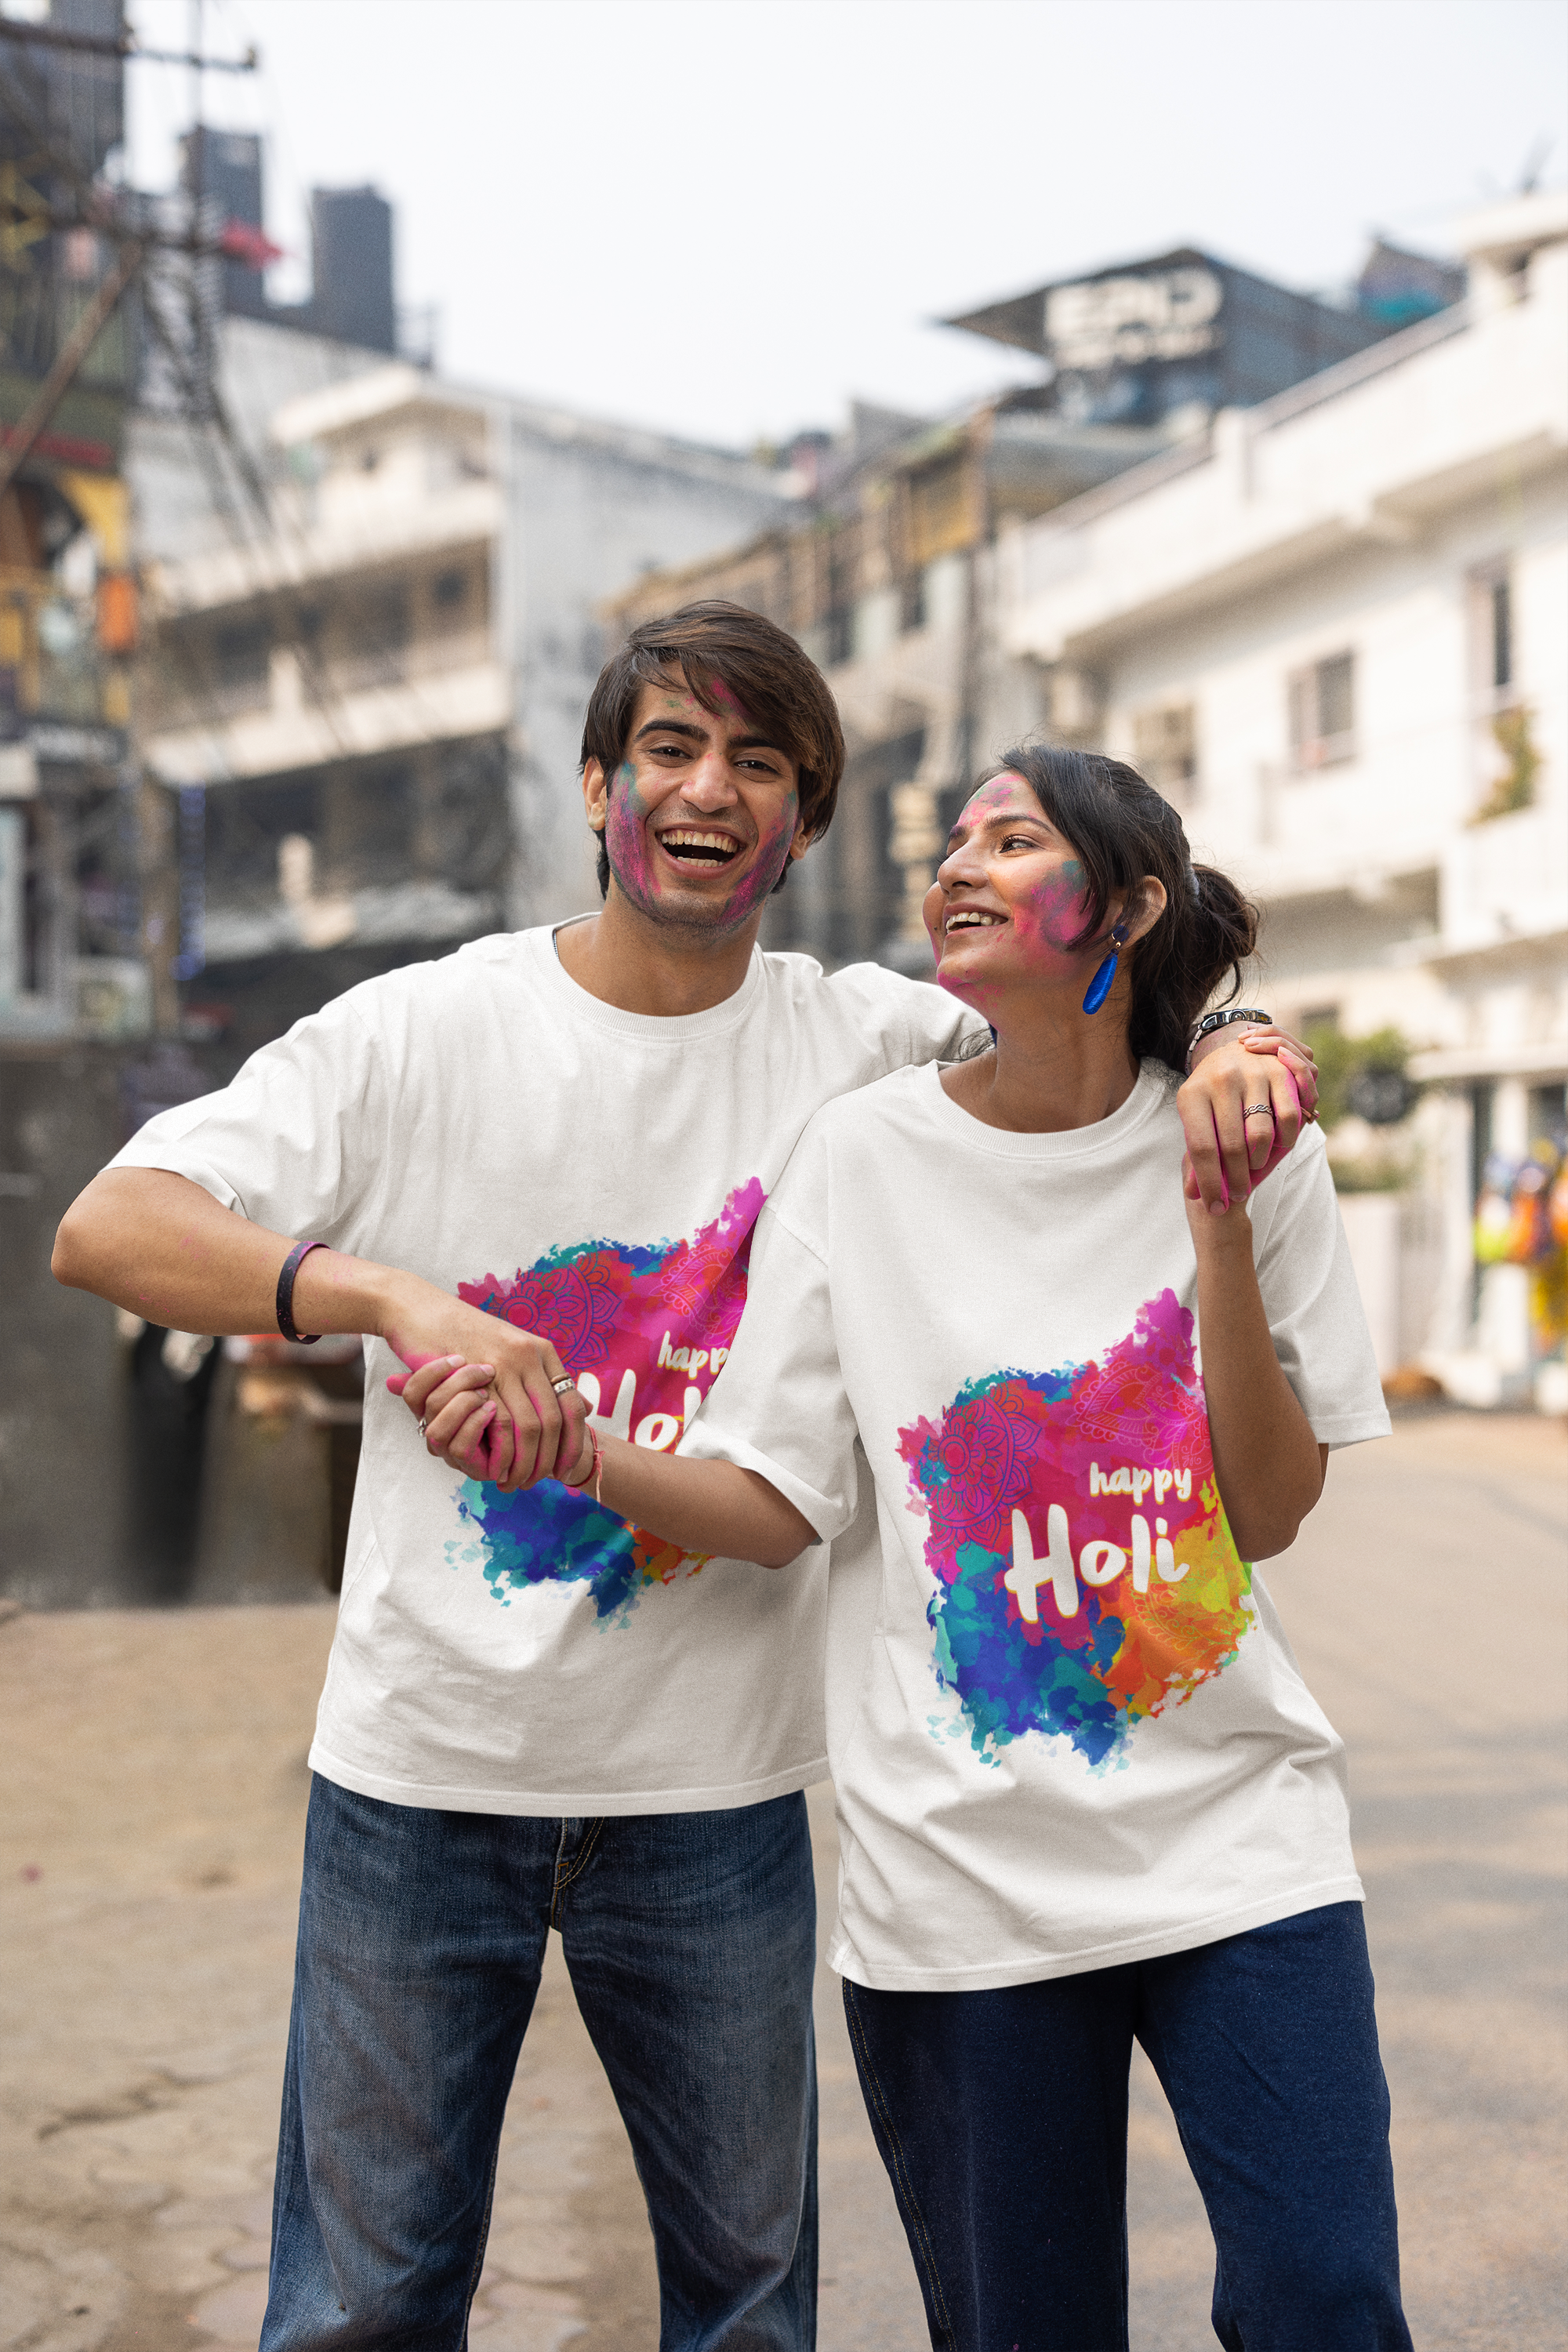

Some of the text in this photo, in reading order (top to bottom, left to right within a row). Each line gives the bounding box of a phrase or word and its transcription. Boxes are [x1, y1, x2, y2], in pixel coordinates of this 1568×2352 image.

[657, 1330, 730, 1380] happ
[1089, 1461, 1192, 1505] happy
[1004, 1503, 1191, 1623] Holi
